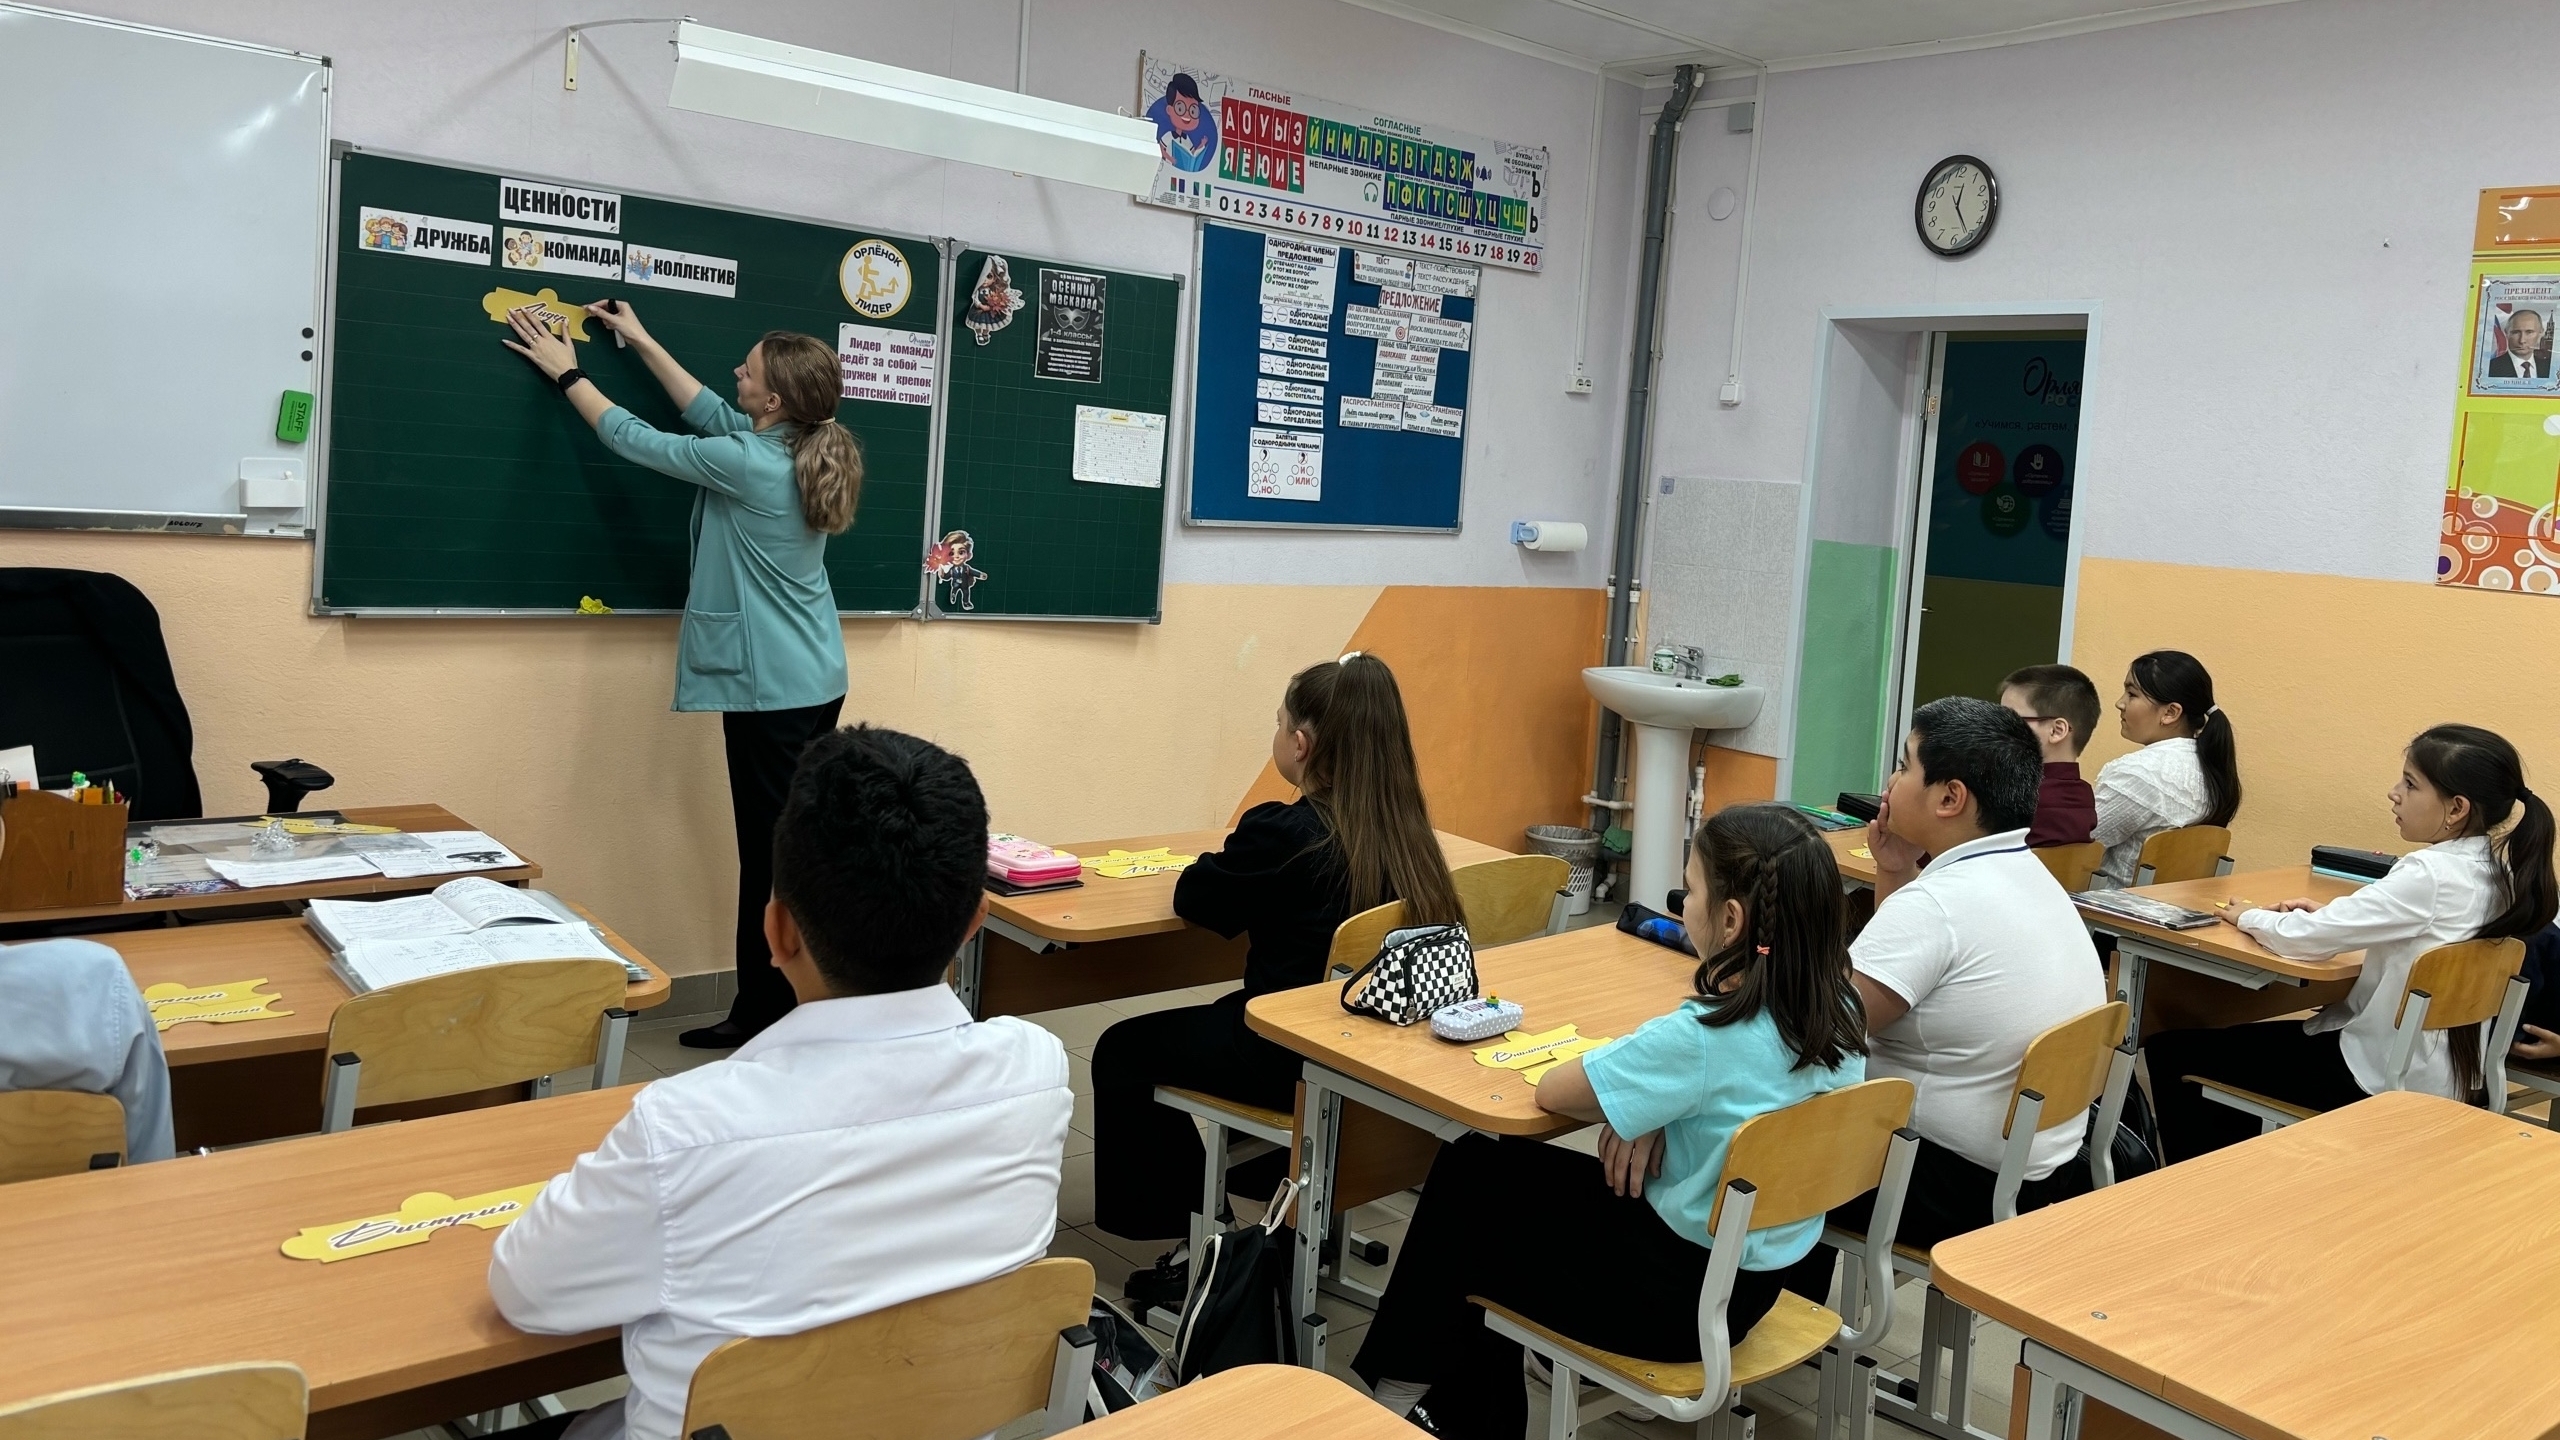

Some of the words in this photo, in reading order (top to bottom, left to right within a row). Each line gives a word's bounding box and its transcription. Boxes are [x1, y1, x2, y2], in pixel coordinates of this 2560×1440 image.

[1249, 88, 1291, 105] ГЛАСНЫЕ
[1225, 107, 1236, 131] А
[1242, 110, 1252, 135] О
[1260, 114, 1270, 138] У
[1275, 117, 1288, 143] Ы
[1293, 122, 1303, 146] Э
[1374, 117, 1421, 136] СОГЛАСНЫЕ
[1310, 119, 1320, 149] Й
[1326, 129, 1336, 153] Н
[1342, 132, 1353, 157] М
[1358, 136, 1368, 160] Л
[1374, 138, 1383, 162] Р
[1389, 142, 1398, 166] Б
[1405, 146, 1414, 169] В
[1420, 149, 1428, 172] Г
[1434, 152, 1443, 177] Д
[1449, 156, 1457, 179] З
[1461, 158, 1474, 182] Ж
[1224, 147, 1235, 172] Я
[1241, 148, 1252, 178] Ё
[1257, 154, 1270, 179] Ю
[1276, 158, 1285, 183] И
[1293, 162, 1301, 186] Е
[1310, 160, 1349, 175] НЕПАРНЫЕ
[1350, 168, 1382, 182] ЗВОНКИЕ
[1955, 166, 1968, 179] 12
[1942, 173, 1952, 184] 11
[1973, 172, 1979, 184] 1
[1532, 171, 1541, 198] Ъ
[1932, 187, 1945, 199] 10
[1978, 185, 1987, 197] 2
[504, 186, 617, 224] ЦЕННОСТИ
[1387, 181, 1396, 205] П
[1401, 185, 1412, 207] Ф
[1417, 187, 1426, 210] К
[1432, 190, 1441, 213] Т
[1447, 193, 1455, 216] С
[1459, 195, 1471, 219] Ш
[1475, 198, 1483, 221] Х
[1488, 200, 1497, 226] Ц
[1503, 204, 1511, 227] Ч
[1514, 206, 1526, 230] Щ
[1927, 201, 1937, 213] 9
[1980, 200, 1989, 212] 3
[1391, 214, 1416, 225] ПАРНЫЕ
[1416, 217, 1465, 233] ЗВОНКИЕ/ГЛУХИЕ
[1530, 207, 1539, 233] Ь
[1928, 216, 1938, 228] 8
[1976, 215, 1984, 225] 4
[1219, 196, 1229, 212] 0
[1233, 199, 1241, 214] 1
[1245, 201, 1255, 217] 2
[1258, 203, 1268, 219] 3
[1272, 206, 1281, 221] 4
[1285, 208, 1294, 223] 5
[1298, 211, 1307, 226] 6
[1311, 213, 1320, 228] 7
[1323, 215, 1332, 230] 8
[1335, 218, 1344, 232] 9
[1348, 220, 1363, 236] 10
[1367, 224, 1380, 239] 11
[1384, 227, 1399, 243] 12
[1402, 230, 1417, 246] 13
[1420, 233, 1436, 248] 14
[1439, 237, 1453, 252] 15
[1456, 240, 1471, 255] 16
[1474, 243, 1488, 258] 17
[1490, 246, 1504, 261] 18
[1507, 249, 1521, 263] 19
[1524, 251, 1538, 266] 20
[1474, 229, 1504, 240] НЕПАРНЫЕ
[1504, 233, 1524, 244] ГЛУХИЕ
[1937, 229, 1946, 240] 7
[1966, 230, 1975, 241] 5
[413, 227, 491, 255] ДРУЖБА
[1950, 234, 1959, 246] 6
[1268, 239, 1312, 253] ОДНОРОДНЫЕ
[1313, 247, 1336, 257] ЧЛЕНЫ
[544, 241, 622, 268] КОМАНДА
[853, 245, 903, 268] ОРЛЁНОК
[1278, 251, 1324, 265] ПРЕДЛОЖЕНИЯ
[1376, 257, 1390, 265] ТЕКСТ
[654, 259, 736, 286] КОЛЛЕКТИВ
[1052, 279, 1096, 298] ОСЕННИЙ
[2504, 287, 2553, 295] ПРЕЗИДЕНТ
[855, 298, 893, 315] ЛИДЕР
[1380, 290, 1441, 313] ПРЕДЛОЖЕНИЕ
[1290, 310, 1329, 322] ОДНОРОДНЫЕ
[1289, 318, 1328, 330] ПОДЛЕЖАЩИЕ
[1050, 328, 1062, 336] 1-4
[849, 337, 882, 352] Лидер
[890, 343, 935, 359] команду
[1288, 336, 1326, 348] ОДНОРОДНЫЕ
[1288, 344, 1320, 355] СКАЗУЕМЫЕ
[840, 353, 869, 366] ведёт
[873, 358, 884, 368] за
[888, 359, 918, 371] собой
[1286, 361, 1328, 372] ОДНОРОДНЫЕ
[1286, 368, 1325, 378] ДОПОЛНЕНИЯ
[884, 374, 890, 384] и
[896, 376, 932, 389] крепок
[1285, 385, 1317, 394] ОДНОРОДНЫЕ
[899, 393, 931, 405] строй!
[1343, 398, 1401, 410] РАСПРОСТРАНЁННОЕ
[294, 402, 307, 433] STAFF
[1283, 408, 1322, 418] ОДНОРОДНЫЕ
[1283, 416, 1322, 426] ОПРЕДЕЛЕНИЯ
[1258, 439, 1296, 448] ОДНОРОДНЫМИ
[1276, 434, 1298, 442] ЗАПЯТЫЕ
[1301, 467, 1306, 475] И
[1263, 475, 1268, 483] А
[1296, 477, 1311, 486] ИЛИ
[1261, 486, 1273, 494] НО
